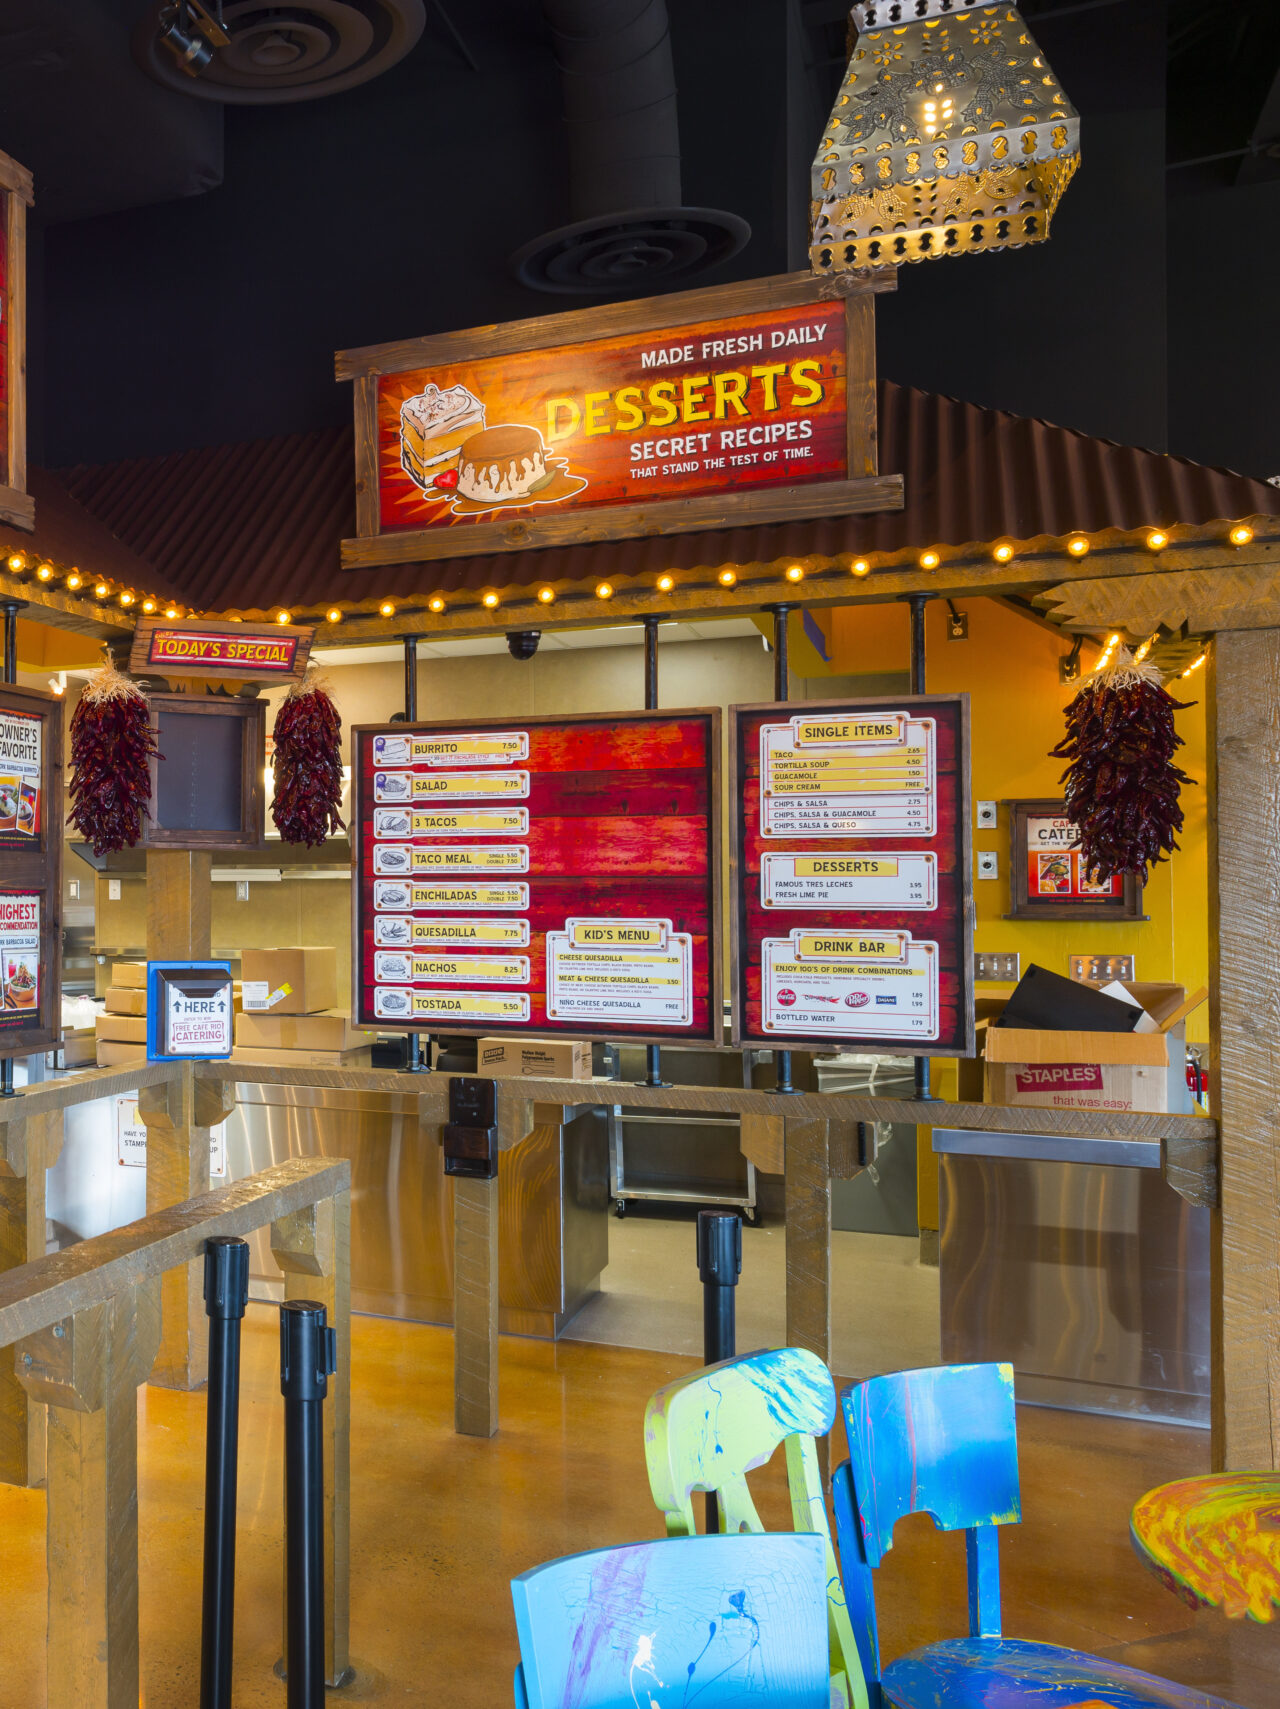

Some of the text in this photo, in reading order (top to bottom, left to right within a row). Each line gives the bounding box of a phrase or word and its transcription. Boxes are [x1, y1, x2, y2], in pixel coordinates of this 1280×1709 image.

[641, 324, 828, 369] MADE FRESH DAILY
[546, 360, 827, 443] DESSERTS
[630, 420, 812, 461] SECRET RECIPES
[630, 446, 814, 479] THAT STAND THE TEST OF TIME.
[157, 639, 289, 662] TODAY'S SPECIAL
[805, 725, 893, 738] SINGLE ITEMS
[415, 743, 458, 754] BURRITO
[416, 781, 448, 791] SALAD
[415, 818, 421, 827] 3
[425, 817, 457, 827] TACOS
[415, 854, 472, 863] TACO MEAL
[813, 861, 879, 872] DESSERTS
[415, 890, 477, 900] ENCHILADAS
[415, 927, 477, 937] QUESADILLA
[584, 930, 650, 941] KID'S MENU
[814, 941, 885, 953] DRINK BAR
[415, 963, 457, 973] NACHOS
[833, 966, 855, 974] DRINK
[858, 967, 913, 975] COMBINATIONS
[610, 976, 649, 984] QUESADILLA
[184, 1001, 215, 1013] HERE
[415, 999, 462, 1010] TOSTADA
[577, 999, 600, 1007] CHEESE
[775, 1013, 808, 1021] BOTTLED
[193, 1023, 208, 1031] CAFE
[176, 1030, 222, 1041] CATERING
[1021, 1067, 1097, 1083] STAPLES
[1053, 1095, 1100, 1107] that was
